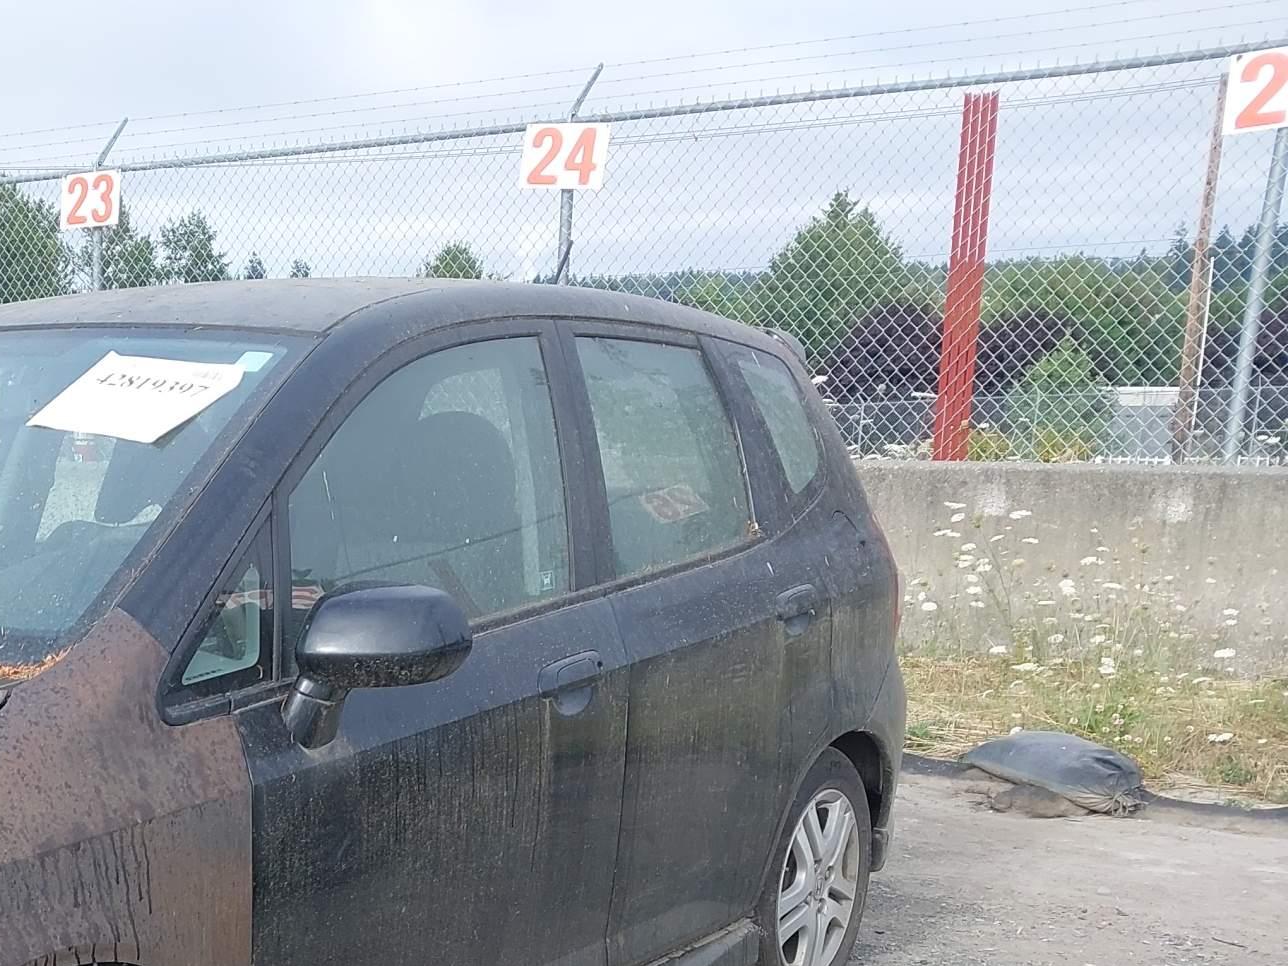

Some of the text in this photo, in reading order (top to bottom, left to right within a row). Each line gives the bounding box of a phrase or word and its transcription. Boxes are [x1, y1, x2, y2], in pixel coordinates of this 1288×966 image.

[527, 127, 596, 185] 24
[67, 175, 114, 225] 23
[96, 372, 210, 397] 42819397
